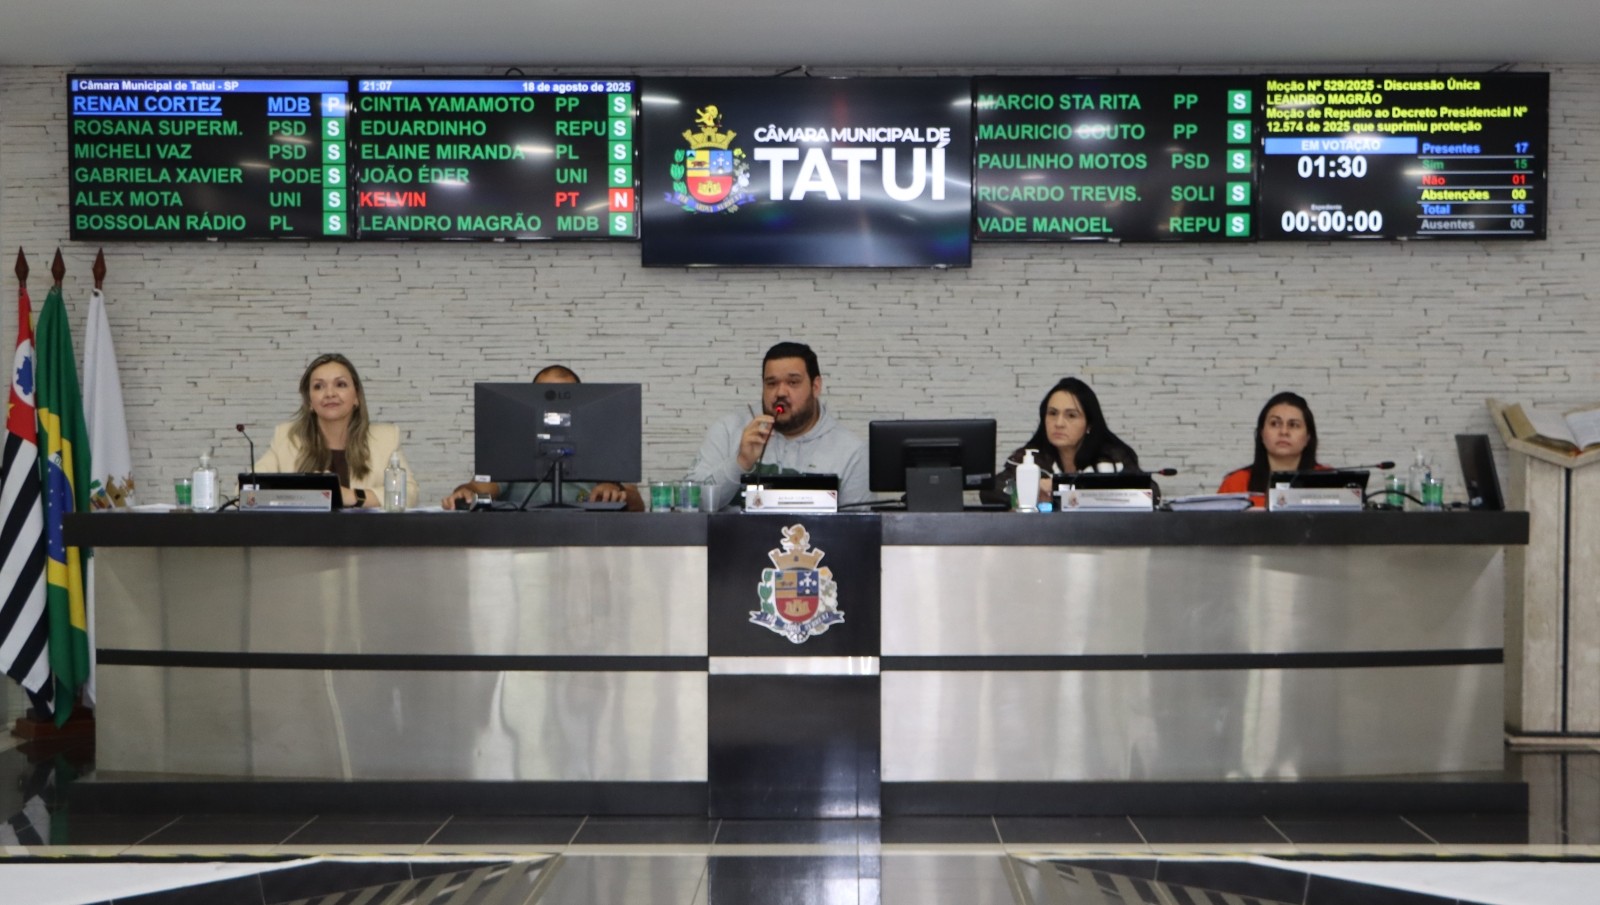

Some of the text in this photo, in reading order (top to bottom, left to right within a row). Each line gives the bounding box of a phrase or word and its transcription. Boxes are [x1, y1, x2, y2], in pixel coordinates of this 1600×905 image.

[79, 80, 119, 90] Câmara
[122, 80, 171, 92] Municipal
[174, 81, 187, 91] de
[224, 81, 239, 91] SP
[363, 81, 392, 91] 21:07
[523, 82, 631, 94] 18 de agosto de 2025
[1267, 81, 1305, 92] Moção
[1323, 80, 1374, 91] 529/2025
[1384, 80, 1443, 90] Discussão
[1447, 77, 1480, 90] Única
[74, 97, 340, 115] RENAN CORTEZ MDB P
[360, 97, 626, 112] CINTIA YAMAMOTO PP S
[980, 94, 1246, 110] MARCIO STA RITA PP S
[1267, 93, 1382, 104] LEANDRO MAGRÃO
[1267, 108, 1305, 119] Moção
[1307, 108, 1321, 118] de
[1324, 107, 1372, 120] Repudio
[1375, 110, 1389, 118] ao
[1392, 108, 1437, 118] Decreto
[1440, 107, 1510, 118] Presidencial
[74, 121, 339, 136] ROSANA SUPERM. PSD S
[361, 121, 626, 136] EDUARDINHO REPU S
[754, 124, 950, 143] CÂMARA MUNICIPAL DE
[979, 124, 1245, 140] MAURICIO COUTO PP S
[1267, 121, 1482, 134] 12.574 de 2025 que suprimiu proteção
[75, 144, 340, 160] MICHELI VAZ PSD S
[361, 144, 626, 159] ELAINE MIRANDA PL S
[1301, 140, 1382, 152] EM VOTAÇÃO
[1422, 143, 1529, 154] Presentes 17
[979, 154, 1245, 169] PAULINHO MOTOS PSD S
[1298, 156, 1367, 177] 01:30
[1422, 160, 1528, 169] Sim 15
[75, 168, 340, 183] GABRIELA XAVIER PODE S
[360, 164, 626, 183] JOÃO ÉDER UNI S
[754, 140, 950, 200] TATUÍ
[1422, 175, 1525, 185] Não 01
[75, 192, 341, 207] ALEX MOTA UNI S
[360, 192, 627, 207] KELVIN PT N
[979, 186, 1244, 201] RICARDO TREVIS. SOLI S
[1421, 189, 1526, 202] Abstenções 00
[1422, 204, 1526, 215] Total 16
[76, 211, 341, 230] BOSSOLAN RÁDIO PL S
[360, 213, 627, 231] LEANDRO MAGRÃO MDB S
[978, 217, 1244, 232] VADE MANOEL REPU S
[1281, 211, 1382, 232] 00:00:00
[1421, 220, 1524, 229] Ausentes 00
[558, 391, 571, 399] LG
